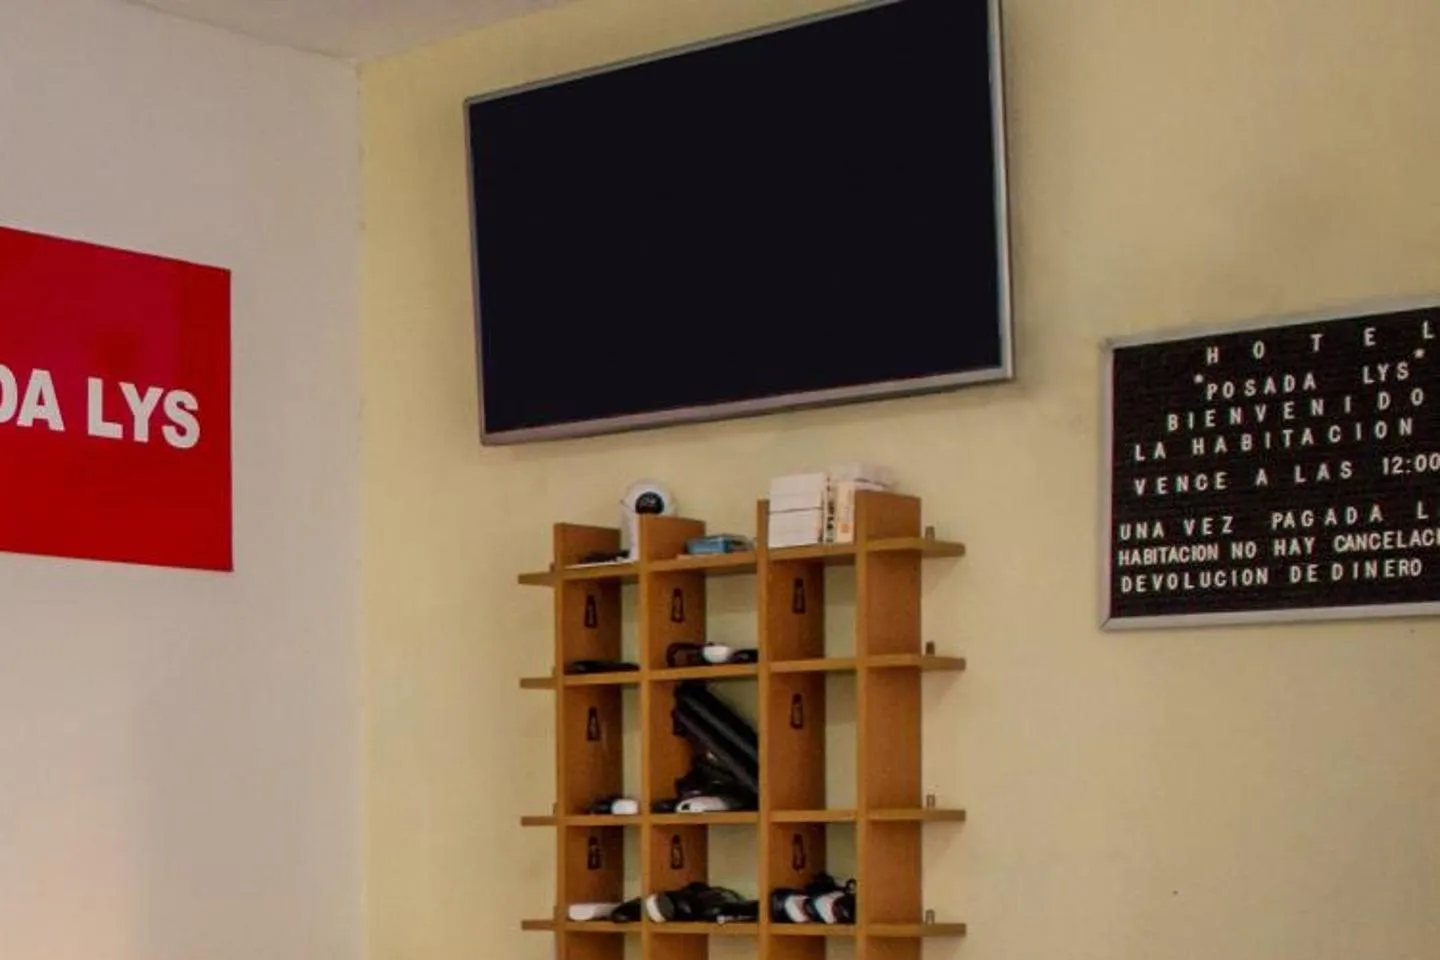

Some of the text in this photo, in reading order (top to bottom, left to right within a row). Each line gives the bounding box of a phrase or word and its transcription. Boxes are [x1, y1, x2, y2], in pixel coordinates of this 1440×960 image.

[1206, 321, 1435, 365] HOTEL
[1206, 361, 1409, 401] POSADA LYS
[86, 376, 201, 449] LYS
[1167, 387, 1424, 432] BIENVENIDO
[1134, 417, 1412, 462] LA HABITACION
[1134, 452, 1440, 497] VENCE A LAS 12:00
[1119, 521, 1165, 541] UNA
[1183, 515, 1233, 537] VEZ
[1271, 504, 1383, 531] PAGADA
[1118, 543, 1219, 567] HABITACION
[1231, 540, 1257, 560] NO
[1273, 536, 1316, 557] HAY
[1120, 558, 1422, 594] DEVOLUCION DE DINERO
